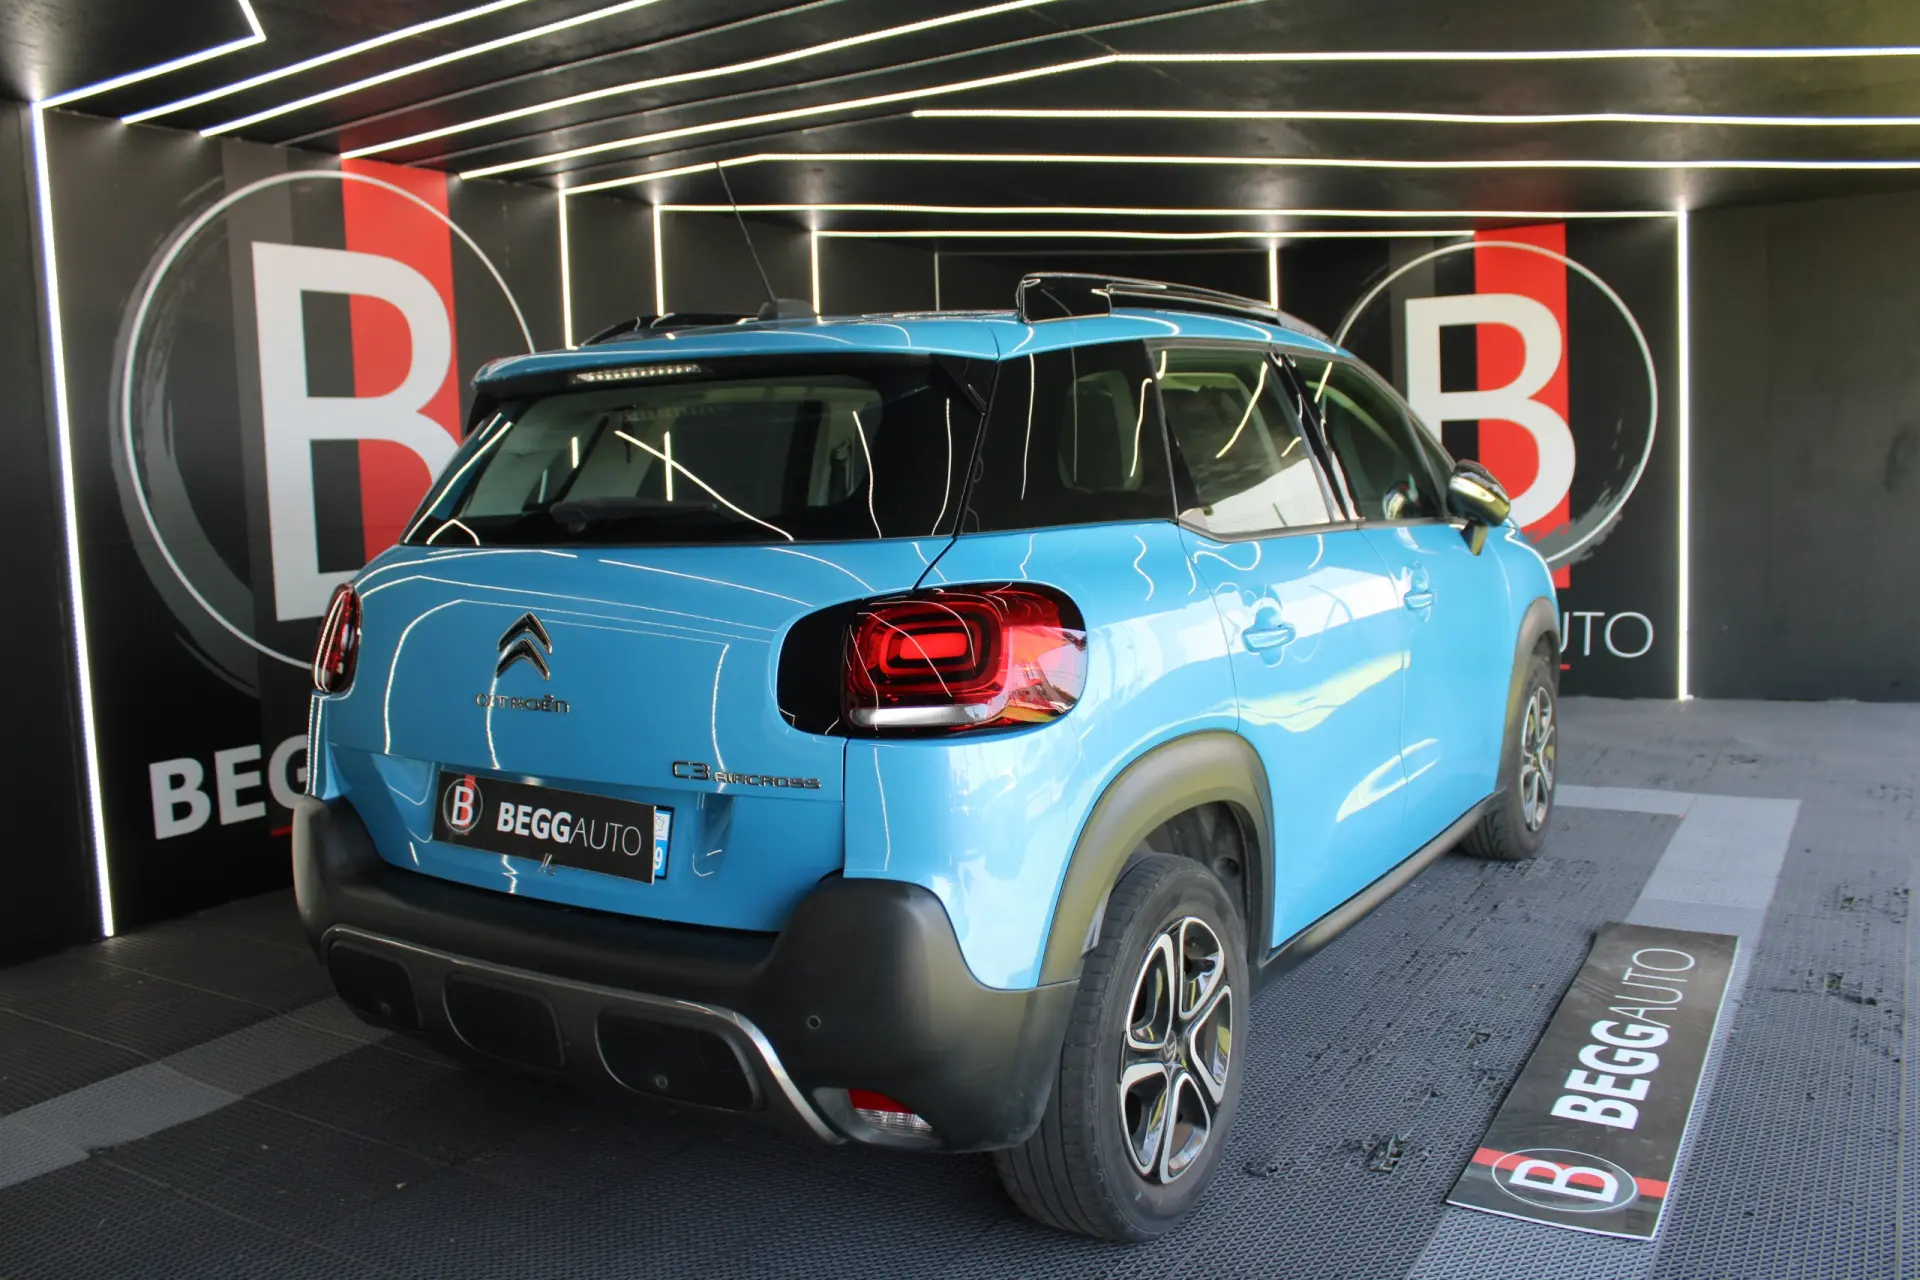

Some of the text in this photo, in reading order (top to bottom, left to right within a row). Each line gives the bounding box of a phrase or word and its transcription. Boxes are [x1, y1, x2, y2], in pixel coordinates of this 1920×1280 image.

[251, 241, 460, 621] B
[1405, 293, 1576, 528] B
[451, 786, 642, 856] B BEGGAUTO
[672, 760, 822, 789] C3 AIRCROSS
[1550, 948, 1695, 1130] BEGGAUTO
[1508, 1158, 1619, 1202] B
